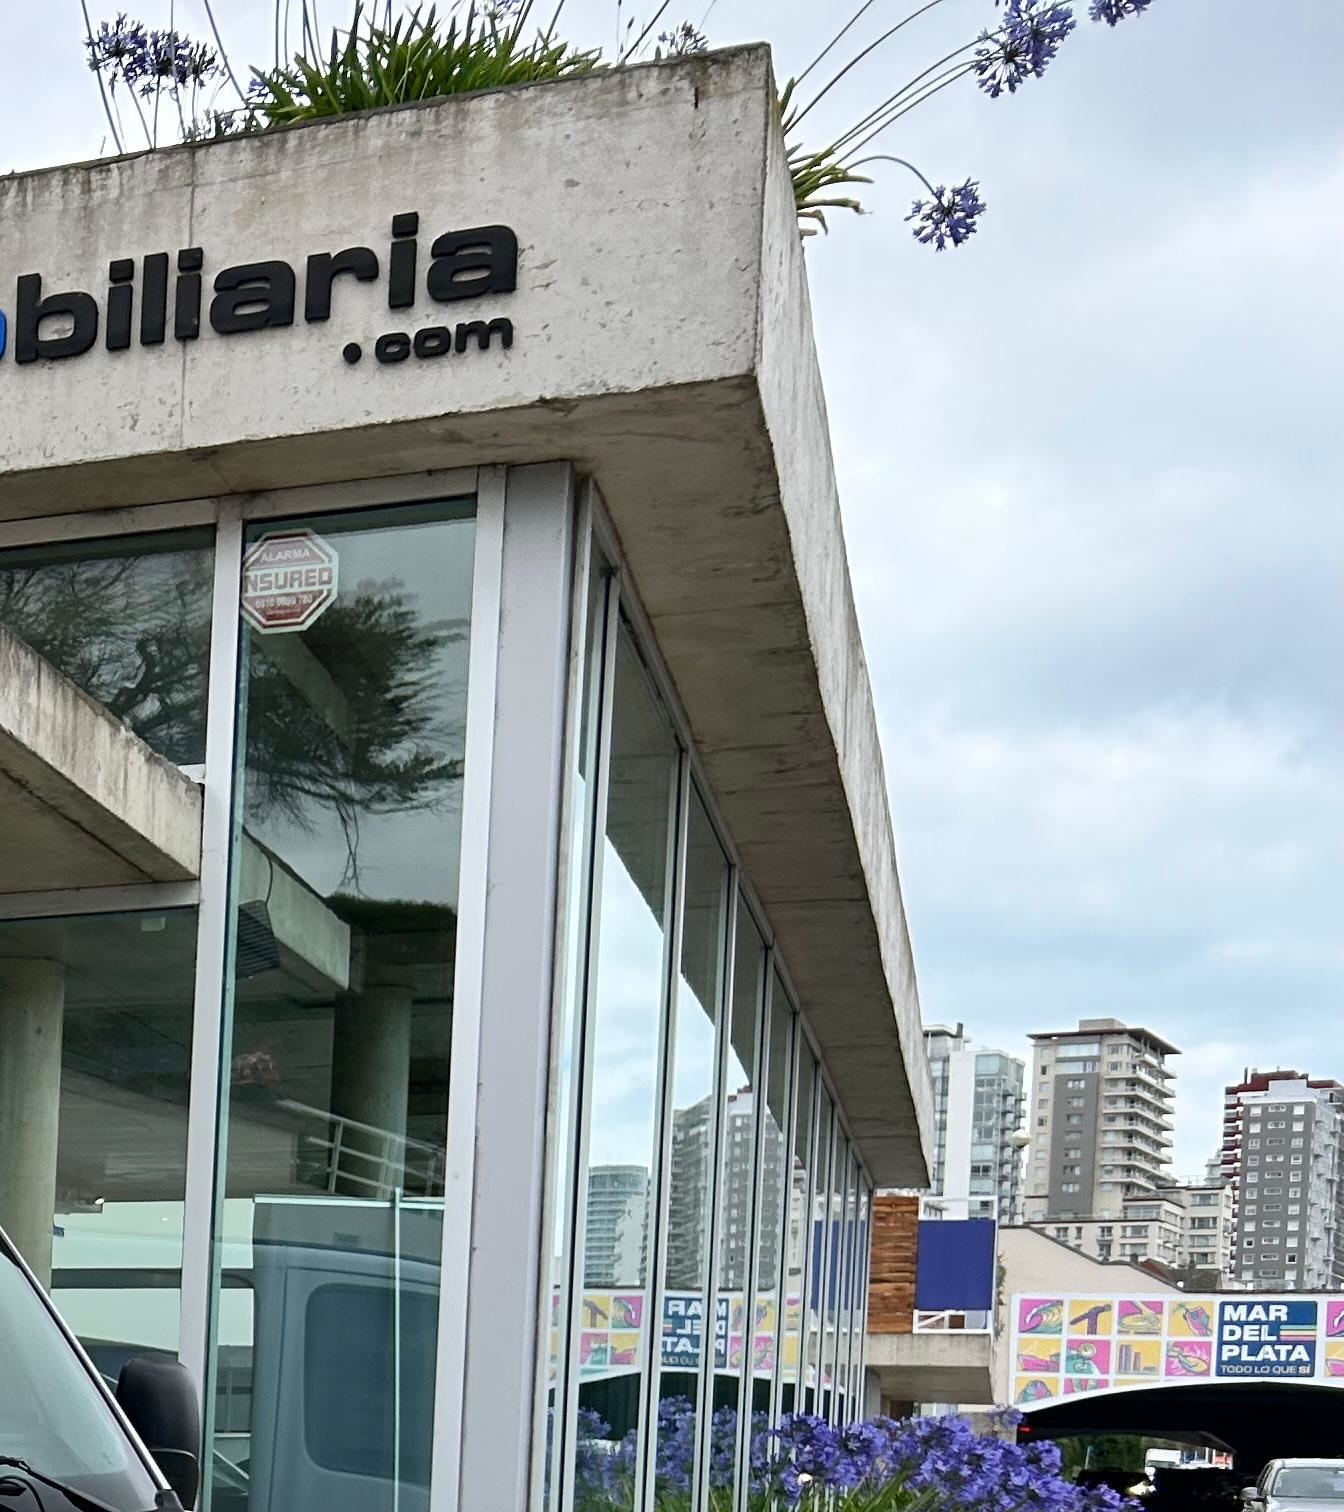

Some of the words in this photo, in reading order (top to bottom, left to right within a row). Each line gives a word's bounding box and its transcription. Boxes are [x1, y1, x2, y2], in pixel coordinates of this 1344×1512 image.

[342, 317, 513, 365] .com
[261, 549, 310, 563] ALARMA
[243, 567, 332, 593] NSURED
[1223, 1304, 1288, 1321] MAR
[1222, 1324, 1277, 1341] DEL
[1221, 1344, 1310, 1361] PLATA
[1221, 1365, 1252, 1374] TODO
[1254, 1365, 1270, 1374] LO
[1272, 1365, 1296, 1375] QUE
